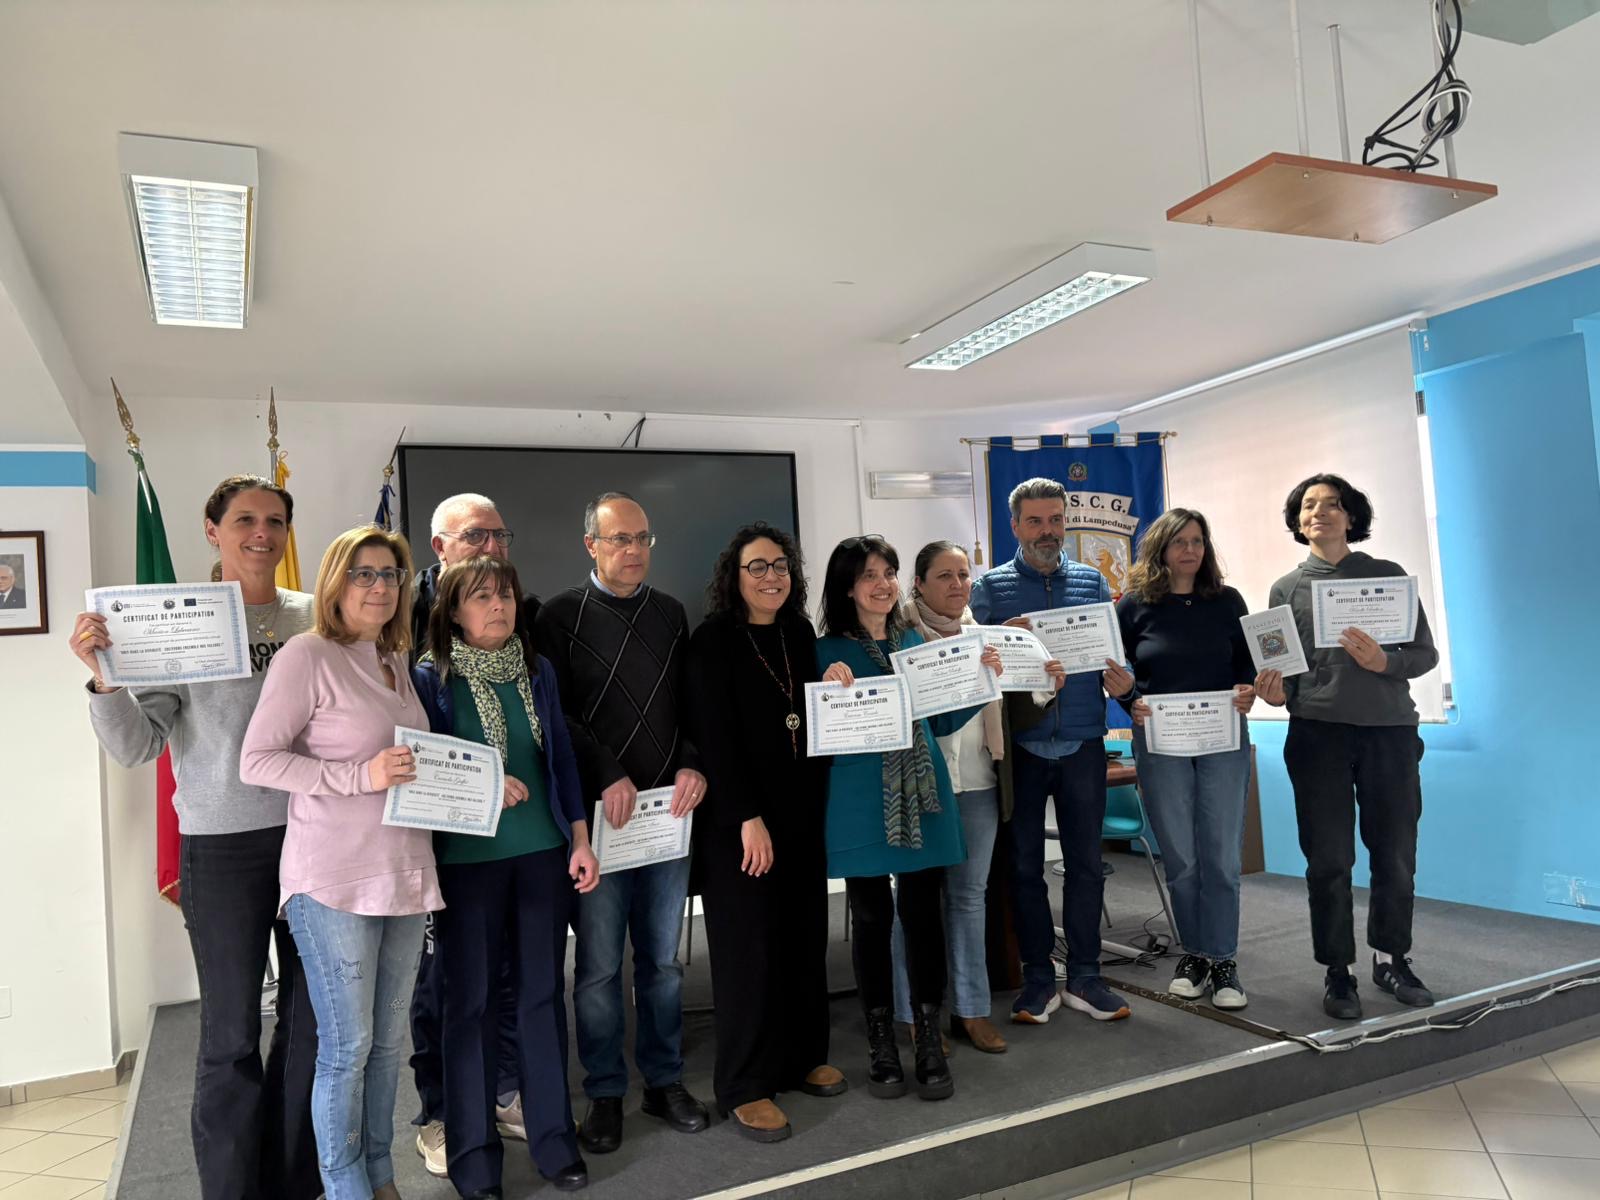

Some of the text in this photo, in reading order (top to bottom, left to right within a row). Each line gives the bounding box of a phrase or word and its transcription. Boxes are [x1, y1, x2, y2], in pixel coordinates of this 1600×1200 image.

[1070, 495, 1127, 514] S. C. G.
[123, 613, 158, 623] CERTIFICAT
[170, 610, 215, 620] PARTICIPATION
[1045, 626, 1065, 634] CERTIFICAT
[1071, 622, 1097, 631] PARTICIPATION
[917, 660, 939, 671] CERTIFICAT
[944, 654, 970, 664] PARTICIPATION
[859, 697, 888, 706] PARTICIPATION
[419, 756, 482, 773] CERTIFICAT DE PARTICIPATION
[643, 808, 671, 818] PARTICIPATIO
